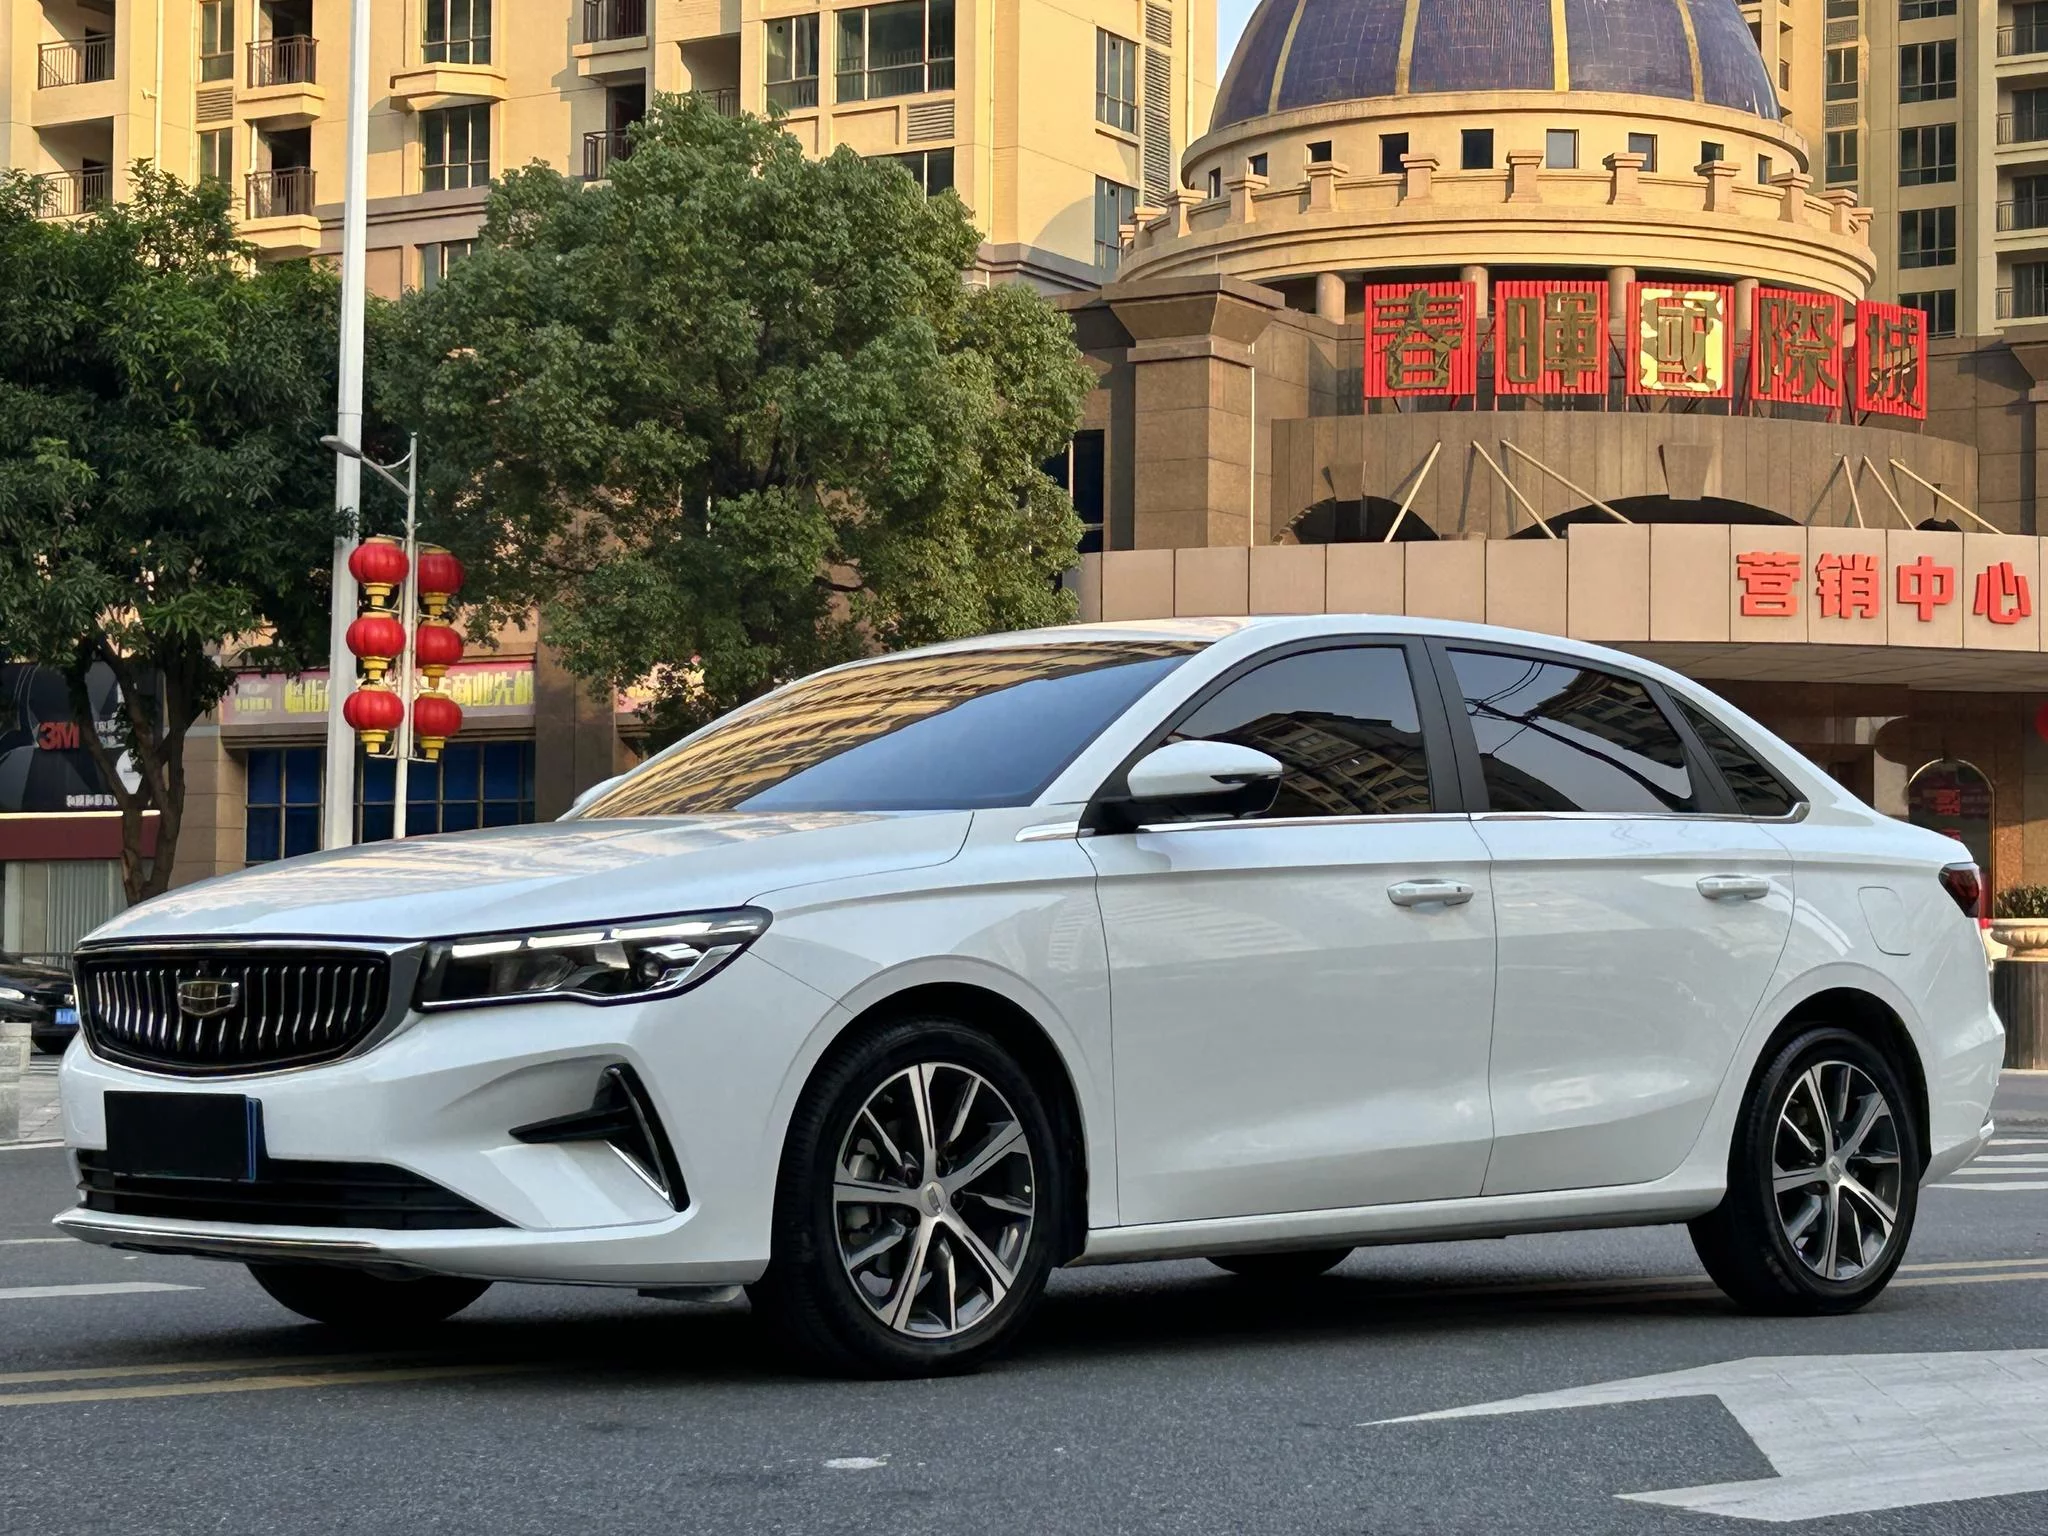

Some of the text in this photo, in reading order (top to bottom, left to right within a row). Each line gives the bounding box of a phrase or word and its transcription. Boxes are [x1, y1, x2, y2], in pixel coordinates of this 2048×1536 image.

[1736, 551, 2032, 625] 营销中心
[39, 721, 80, 750] 3M
